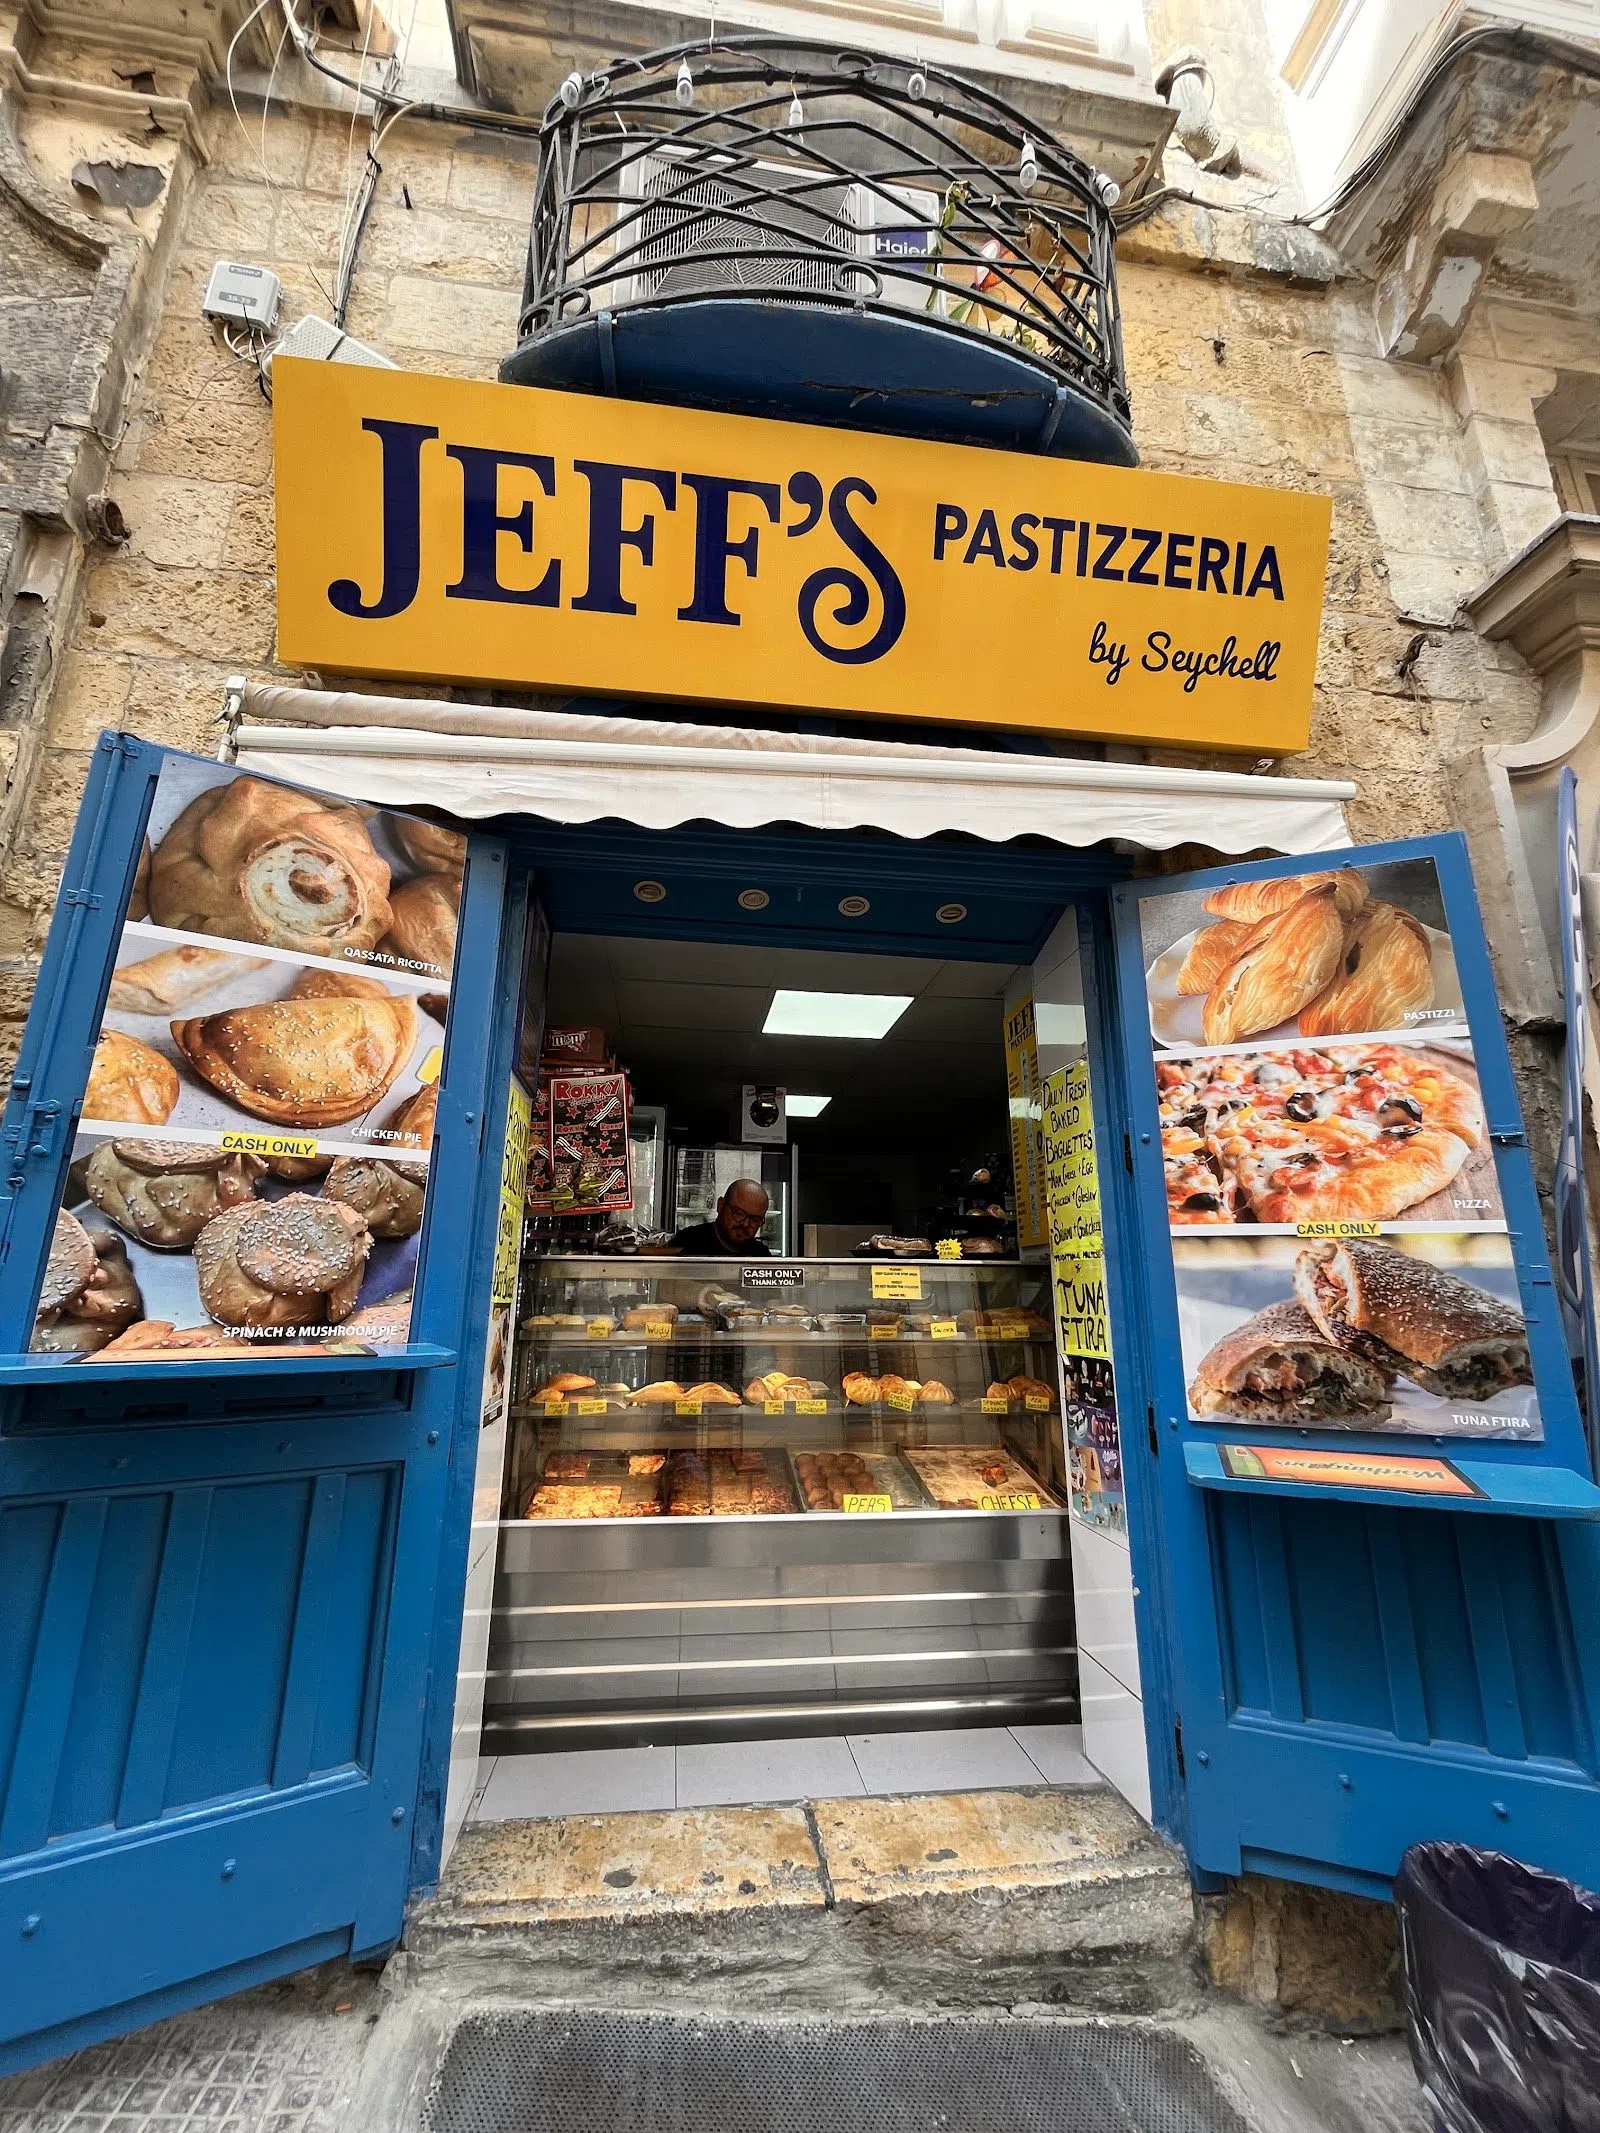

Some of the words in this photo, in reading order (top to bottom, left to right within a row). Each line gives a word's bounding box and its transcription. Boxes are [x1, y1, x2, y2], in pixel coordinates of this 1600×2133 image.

[876, 237, 927, 255] Haier
[328, 418, 906, 665] JEFF'S
[933, 503, 1285, 601] PASTIZZERIA
[1088, 621, 1130, 685] by
[1141, 631, 1282, 693] Seychell
[343, 947, 396, 965] QASSATA
[397, 957, 442, 974] RICOTTA
[1403, 1008, 1456, 1021] PASTIZZI
[555, 1080, 620, 1100] ROKKY
[1050, 1105, 1080, 1133] BAKED
[351, 1127, 403, 1141] CHICKEN
[404, 1131, 423, 1143] PIE
[222, 1136, 267, 1151] CASH
[272, 1140, 314, 1155] ONLY
[1046, 1129, 1093, 1164] BAGUETTES
[1453, 1199, 1492, 1209] PIZZA
[1297, 1223, 1336, 1235] CASH
[1339, 1223, 1378, 1235] ONLY
[744, 1269, 777, 1279] CASH
[778, 1269, 802, 1279] ONLY
[751, 1279, 777, 1287] THANK
[778, 1279, 795, 1287] YOU
[1057, 1278, 1107, 1316] TUNA
[222, 1326, 284, 1338] SPINACH
[285, 1326, 296, 1338] &
[298, 1326, 376, 1338] MUSHROOM
[378, 1325, 398, 1337] PIE
[1061, 1315, 1108, 1353] FTIRA
[1451, 1414, 1489, 1426] TUNA
[1491, 1416, 1531, 1428] FTIRA
